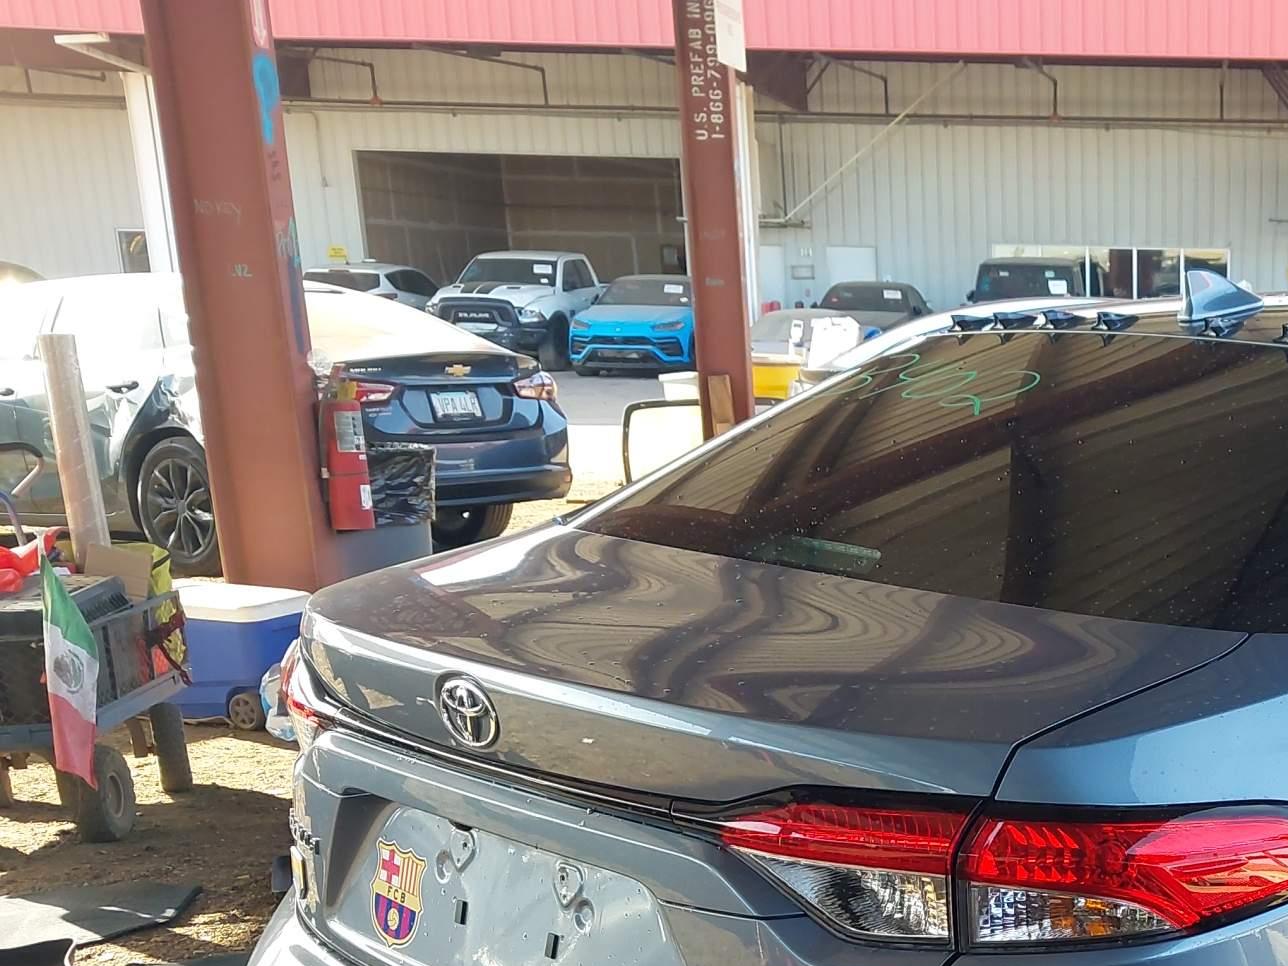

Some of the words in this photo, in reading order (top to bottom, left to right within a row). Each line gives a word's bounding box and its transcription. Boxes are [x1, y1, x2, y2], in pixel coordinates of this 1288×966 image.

[686, 0, 701, 18] IN
[688, 28, 706, 97] PREFAB
[695, 107, 709, 140] U.S.
[387, 885, 406, 904] FCB
